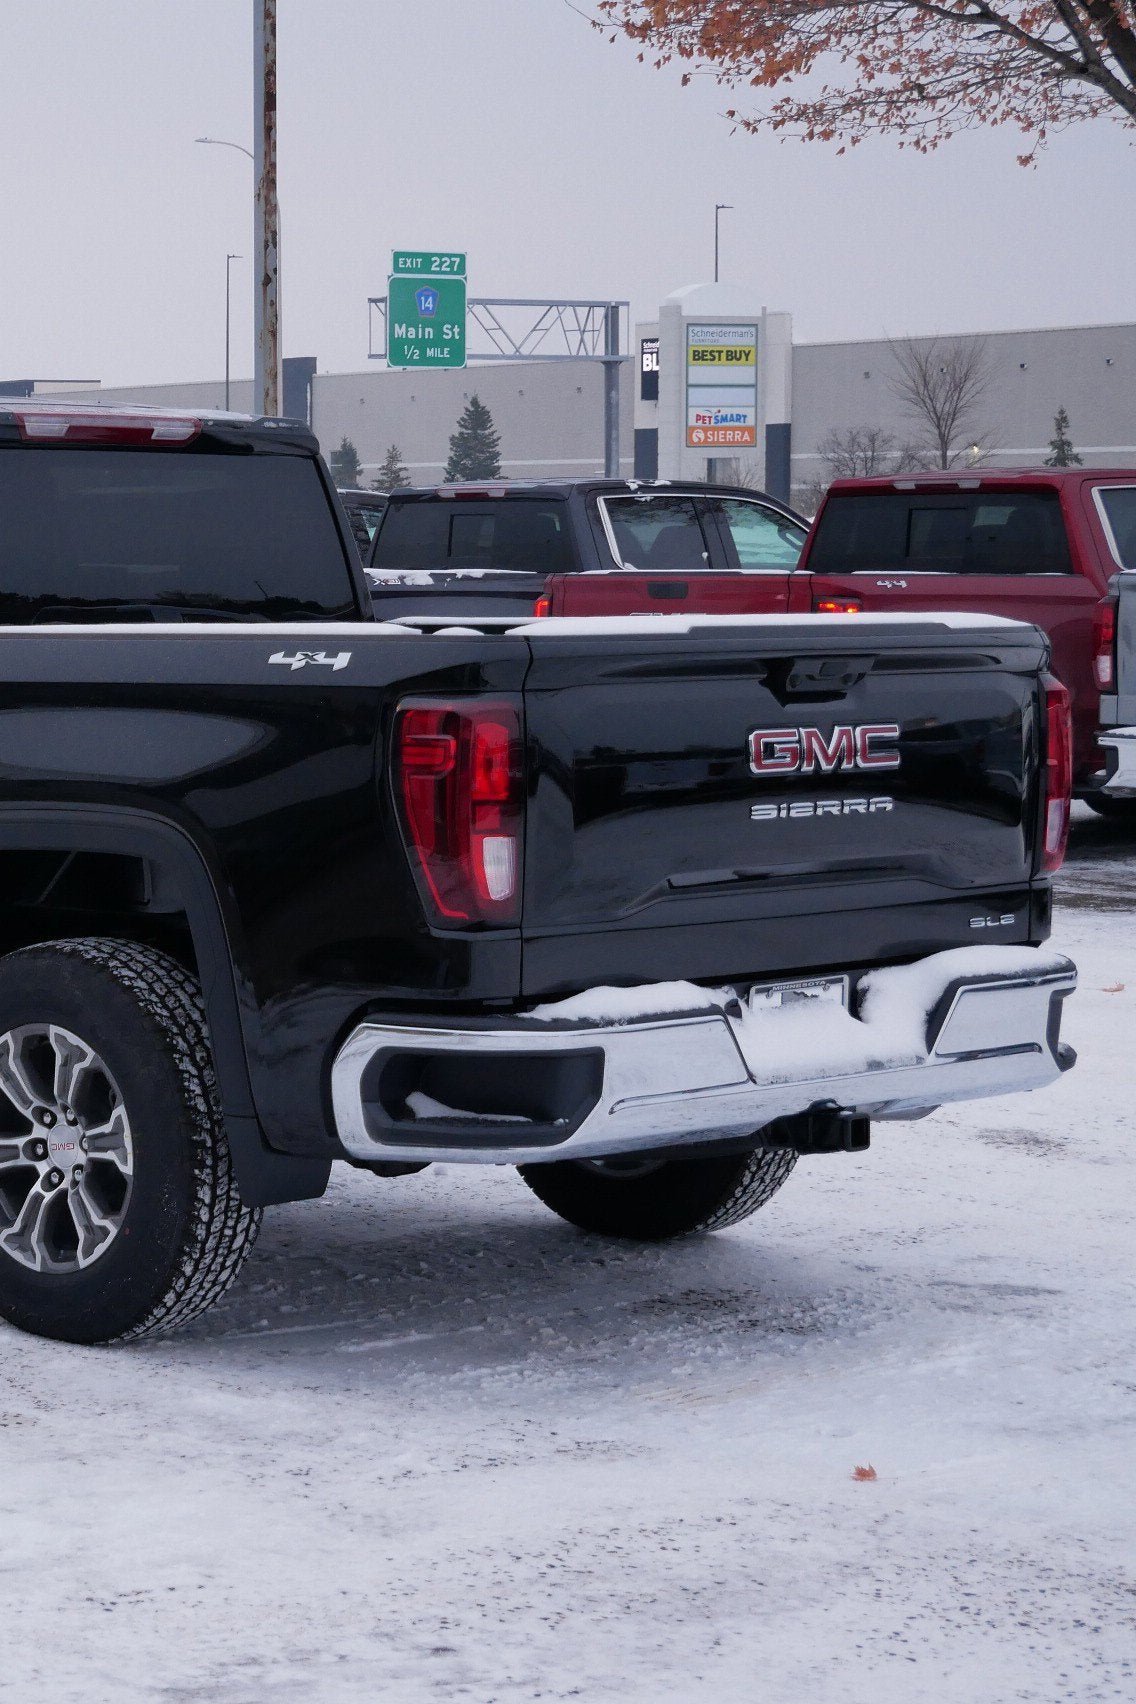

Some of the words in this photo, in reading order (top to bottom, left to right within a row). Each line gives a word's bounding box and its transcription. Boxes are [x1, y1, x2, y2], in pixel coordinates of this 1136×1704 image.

[398, 258, 423, 269] EXIT
[430, 256, 461, 272] 227
[419, 296, 434, 310] 14
[394, 323, 434, 339] Main
[442, 323, 461, 340] St
[691, 328, 754, 338] Schneiderman's
[426, 347, 450, 358] MILE
[692, 349, 724, 362] BEST
[725, 349, 752, 362] BUY
[706, 430, 751, 442] SIERRA
[748, 723, 901, 774] GMC
[750, 796, 894, 821] SIERRA
[772, 980, 826, 991] MINNESOTA
